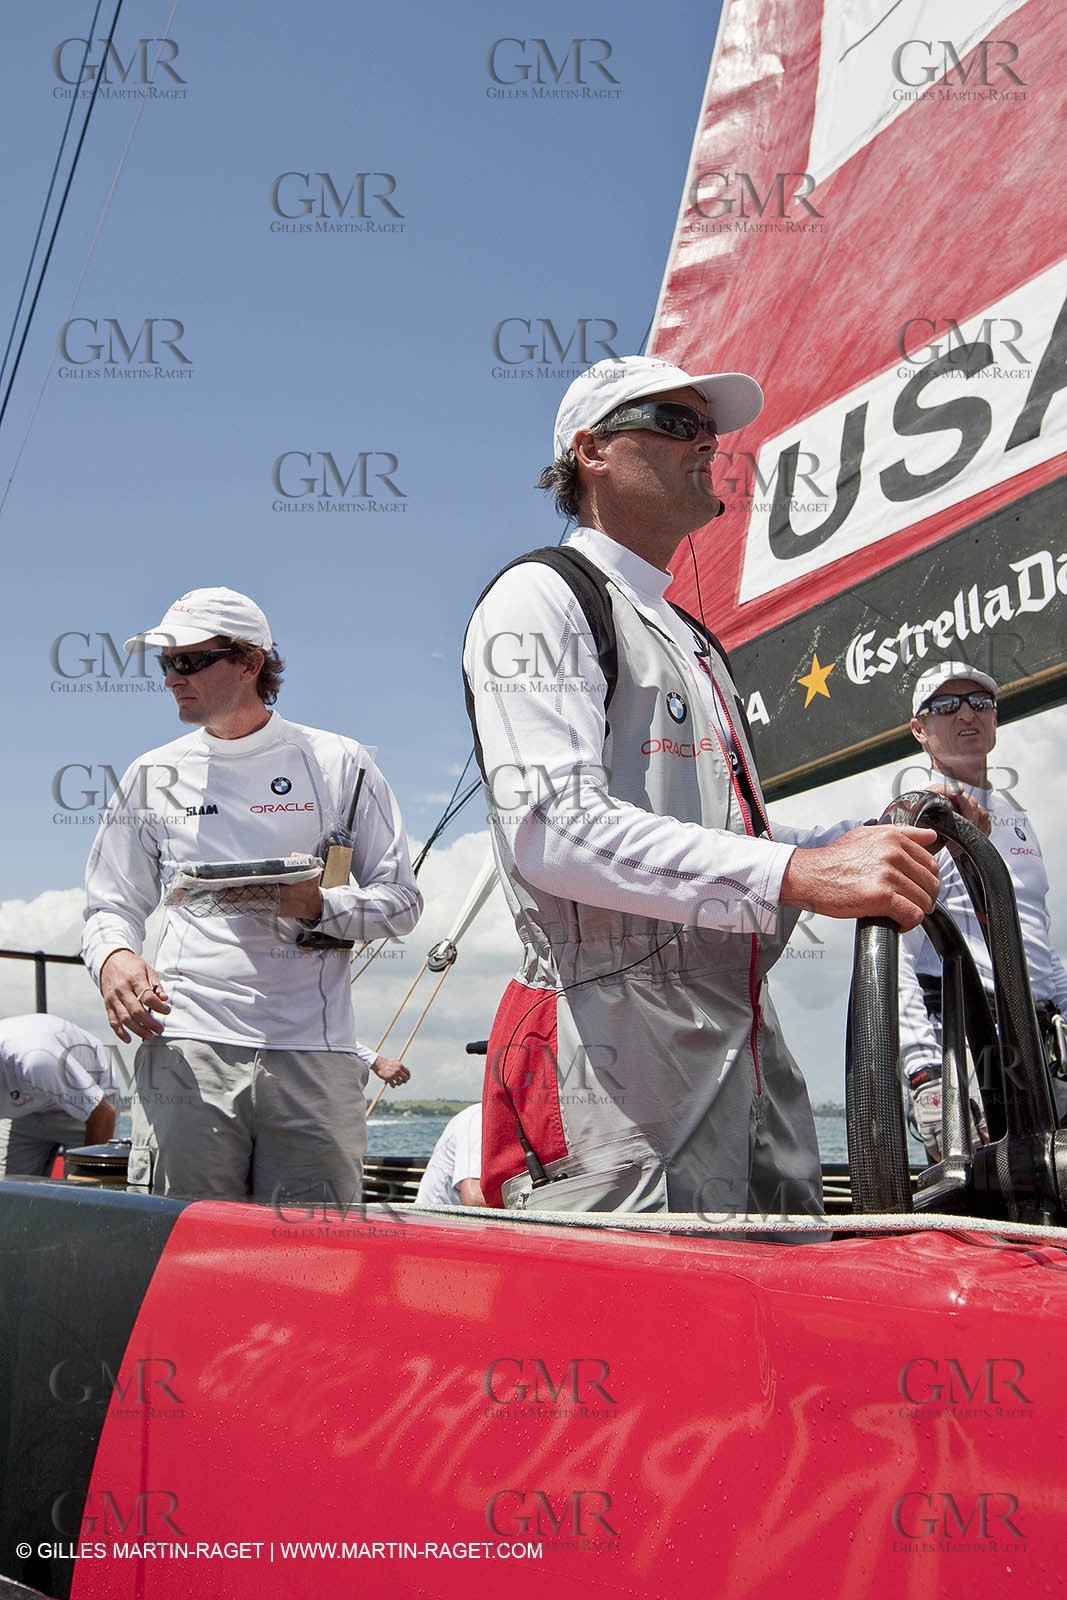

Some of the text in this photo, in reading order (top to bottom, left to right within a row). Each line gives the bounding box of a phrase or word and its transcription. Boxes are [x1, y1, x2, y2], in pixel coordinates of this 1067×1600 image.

[845, 583, 1014, 684] Estrella
[641, 738, 714, 758] ORACLE
[185, 804, 219, 817] SLAM
[250, 802, 315, 814] ORACLE
